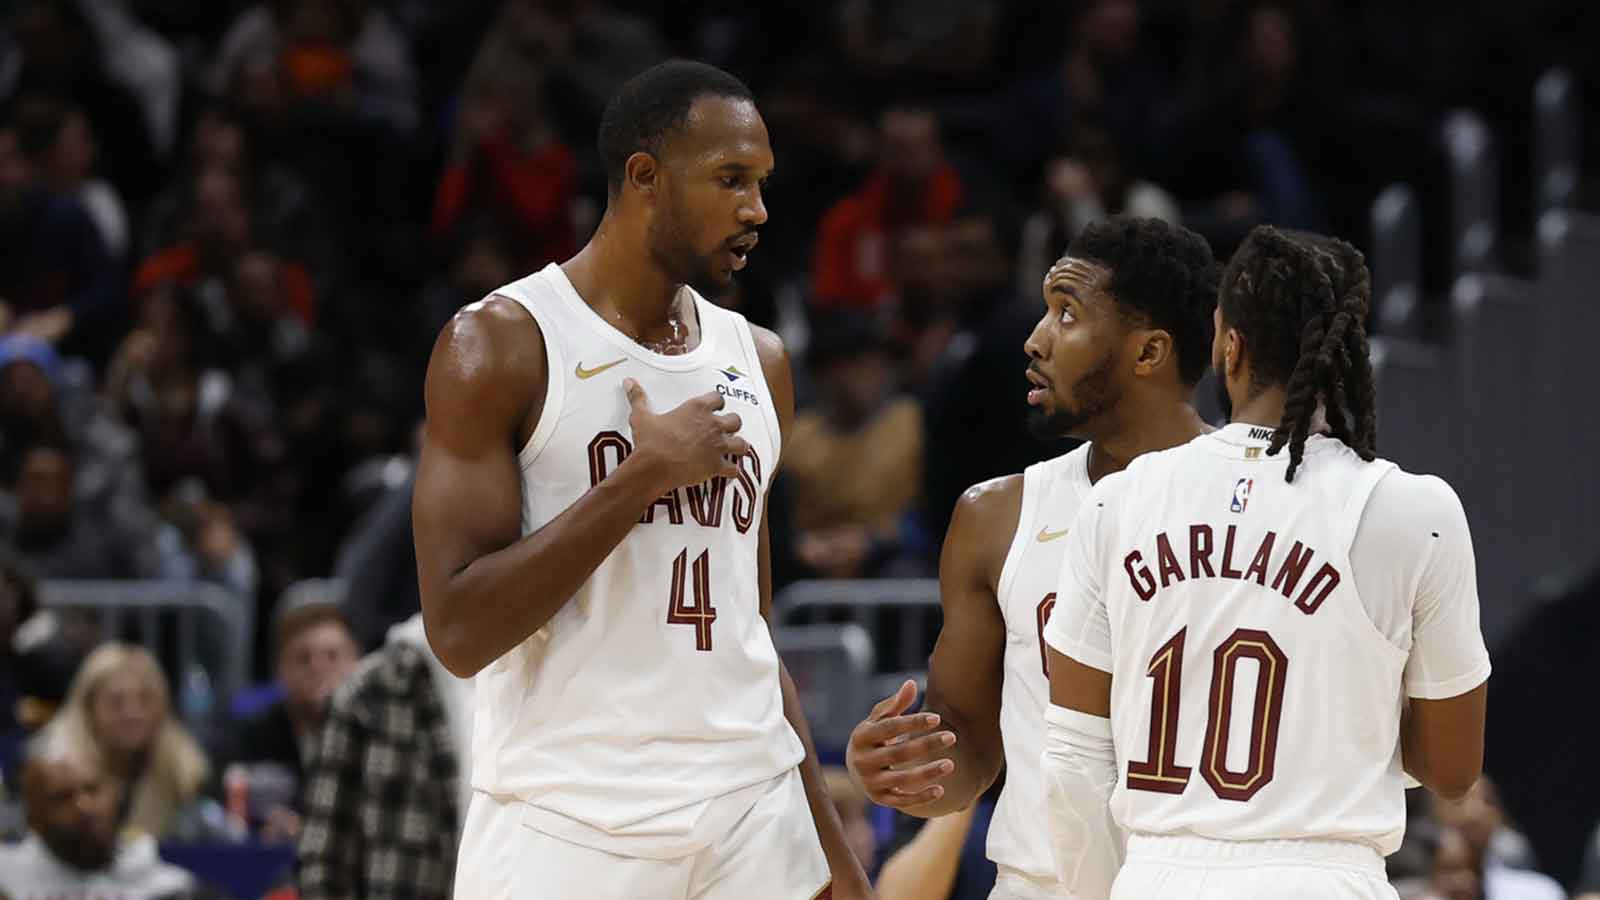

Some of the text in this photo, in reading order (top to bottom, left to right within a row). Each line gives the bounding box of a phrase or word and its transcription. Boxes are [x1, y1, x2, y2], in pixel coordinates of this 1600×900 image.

[716, 384, 759, 406] CLIFFS
[1248, 427, 1273, 441] NIK
[666, 547, 717, 651] 4
[1124, 524, 1341, 616] GARLAND
[1127, 625, 1289, 802] 10
